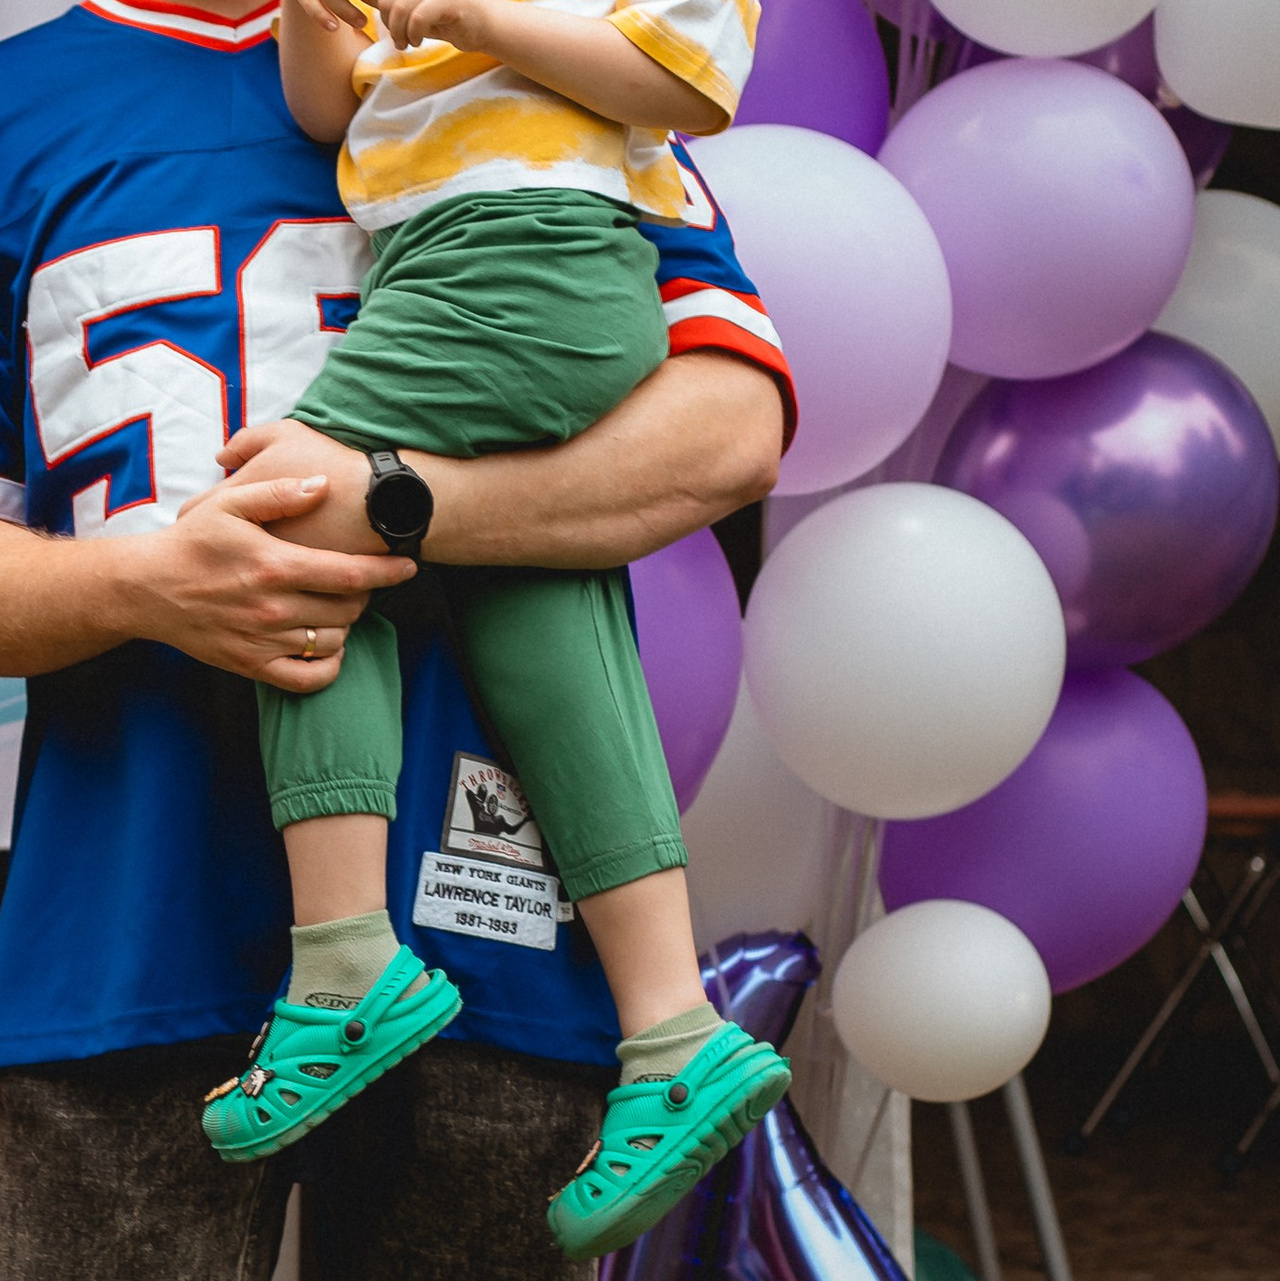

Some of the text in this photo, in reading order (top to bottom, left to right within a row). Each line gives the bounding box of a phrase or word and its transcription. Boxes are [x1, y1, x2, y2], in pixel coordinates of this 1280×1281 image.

[435, 862, 547, 892] NEW YORK GIANTS
[424, 881, 553, 919] LAWRENCE TAYLOR
